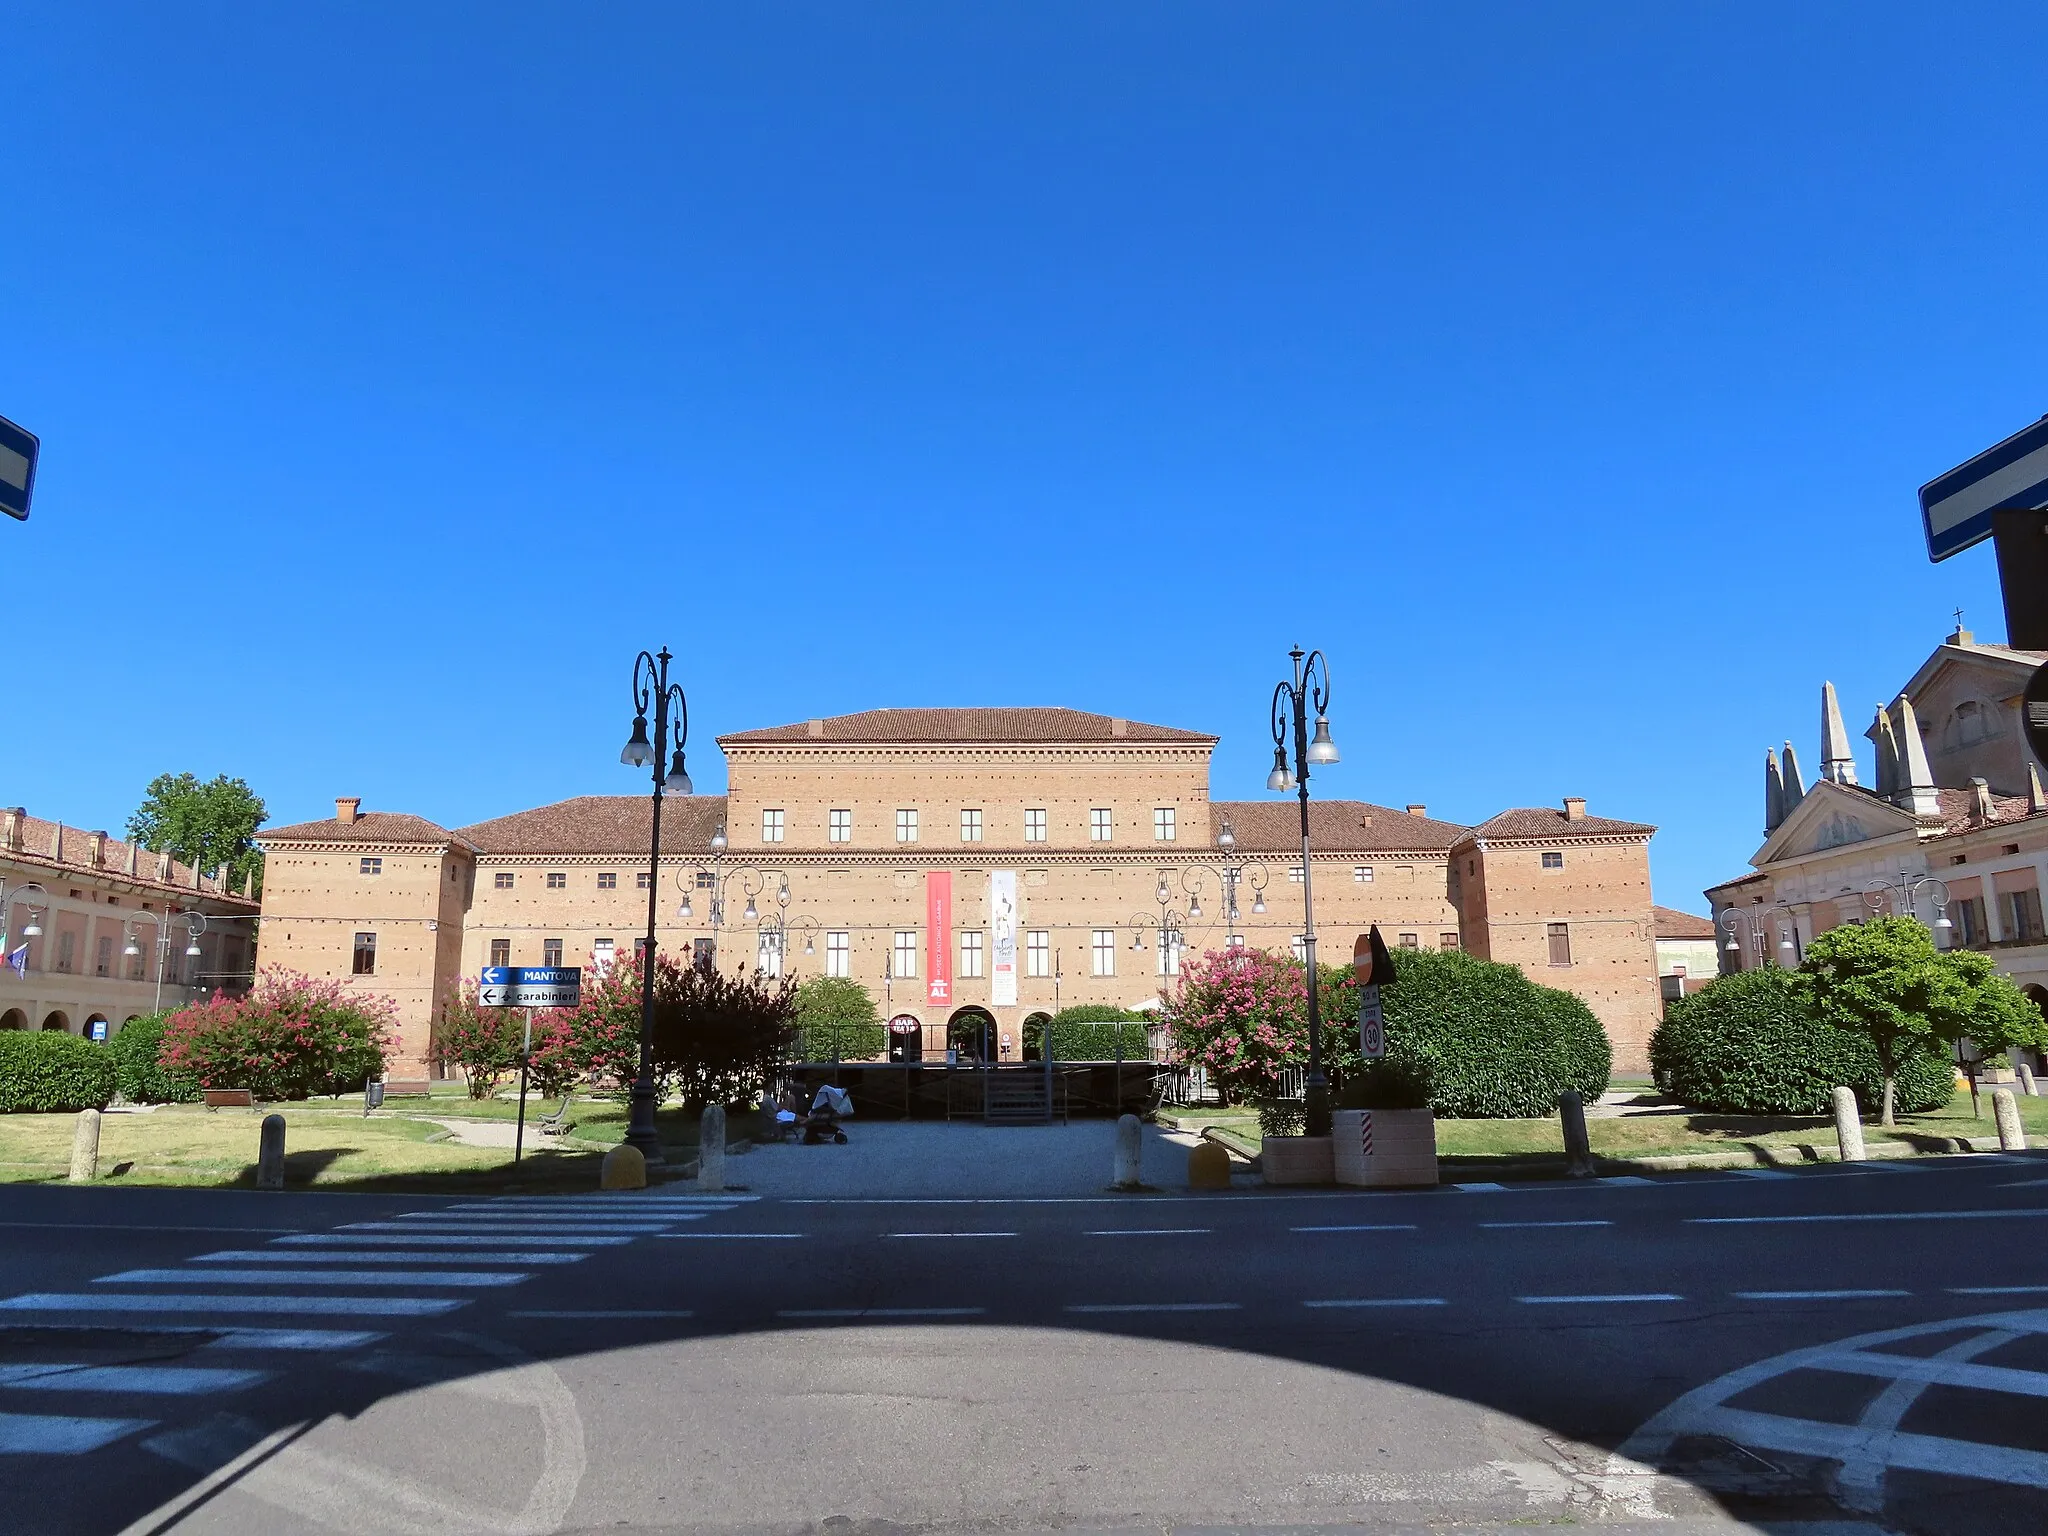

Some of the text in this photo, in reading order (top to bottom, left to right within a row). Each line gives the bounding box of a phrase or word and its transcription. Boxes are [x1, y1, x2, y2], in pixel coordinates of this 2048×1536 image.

[524, 972, 577, 980] MANTOVA
[516, 992, 576, 1000] carabinieri
[930, 987, 948, 997] AL
[1368, 1028, 1377, 1044] 30
